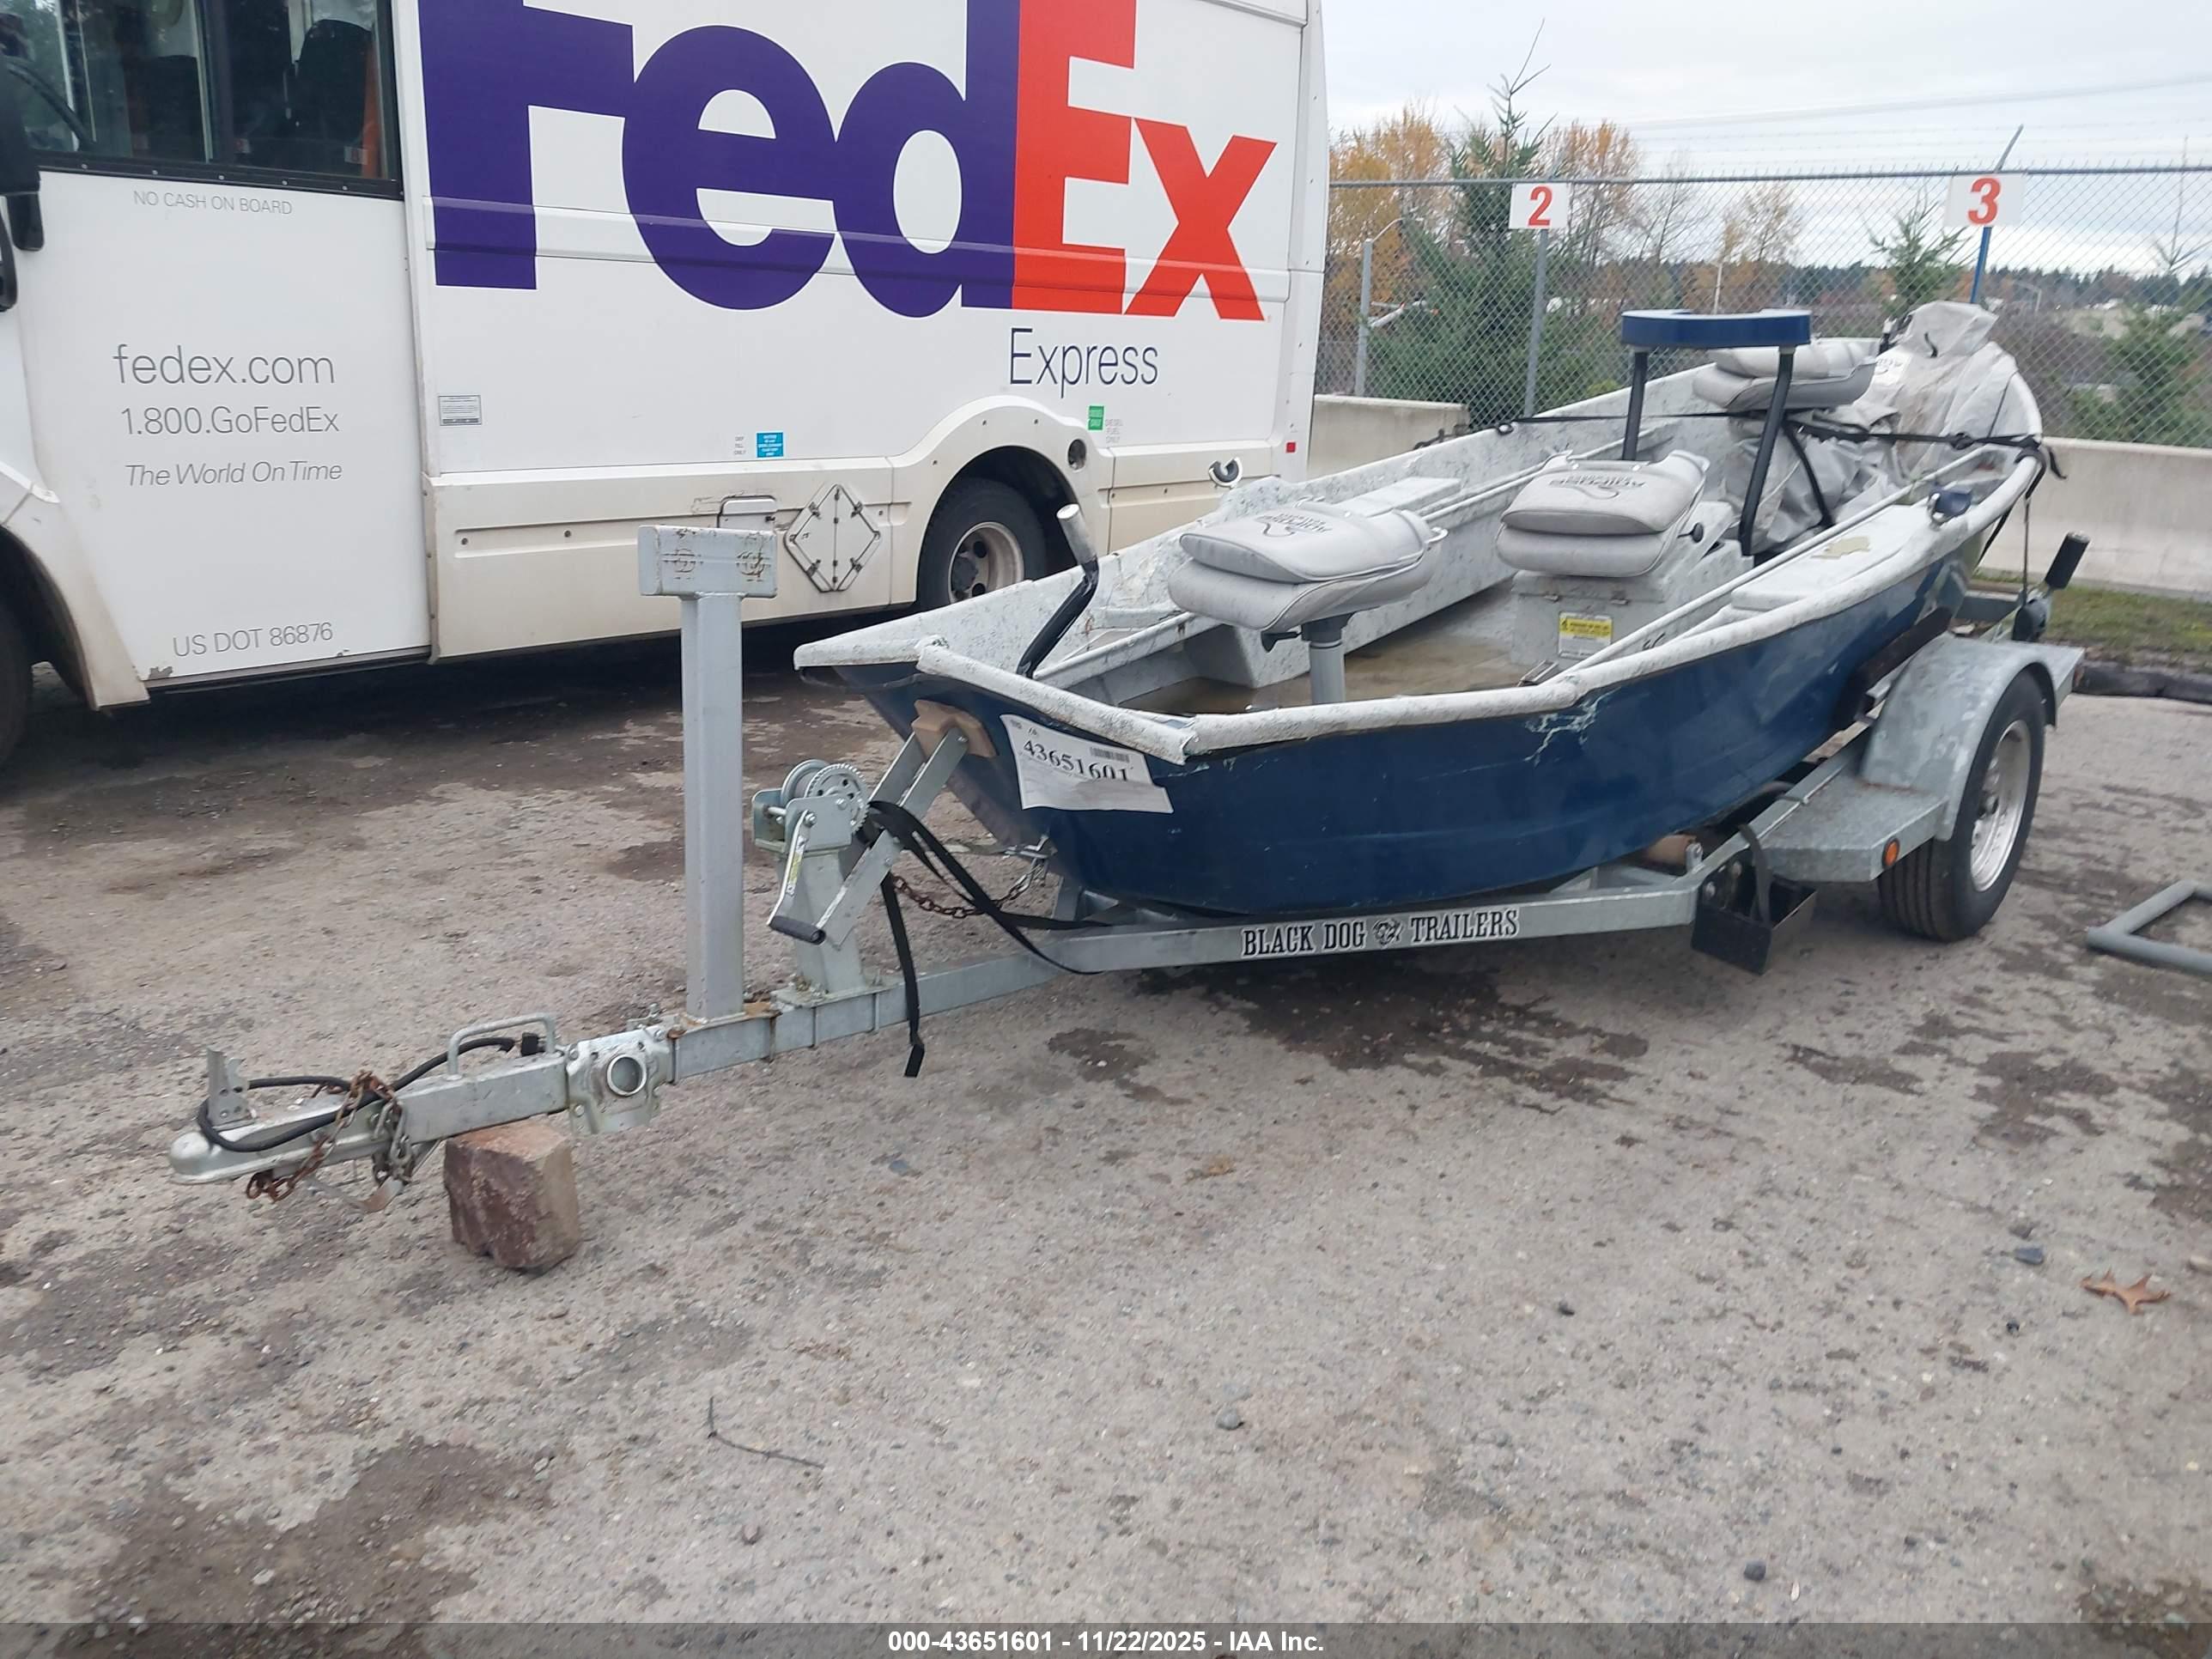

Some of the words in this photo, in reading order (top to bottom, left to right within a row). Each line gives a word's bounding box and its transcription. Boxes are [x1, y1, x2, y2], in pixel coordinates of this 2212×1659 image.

[419, 0, 1277, 322] FedEx
[133, 190, 159, 206] NO
[163, 192, 207, 210] CASH
[211, 195, 235, 211] ON
[240, 198, 293, 215] BOARD
[1528, 185, 1553, 228] 2
[1967, 177, 2001, 225] 3
[112, 343, 335, 385] fedex.com
[1009, 327, 1158, 399] Express
[120, 405, 340, 435] 1.800.GoFedEx
[125, 465, 171, 487] The
[176, 462, 246, 485] World
[252, 461, 285, 483] On
[289, 460, 343, 482] Time
[173, 634, 208, 657] US
[213, 628, 264, 653] DOT
[269, 622, 333, 647] 86876
[1023, 739, 1127, 781] 43651601
[1243, 924, 1314, 957] BLACK
[1322, 921, 1365, 950] DOG
[1411, 910, 1517, 943] TRAILERS
